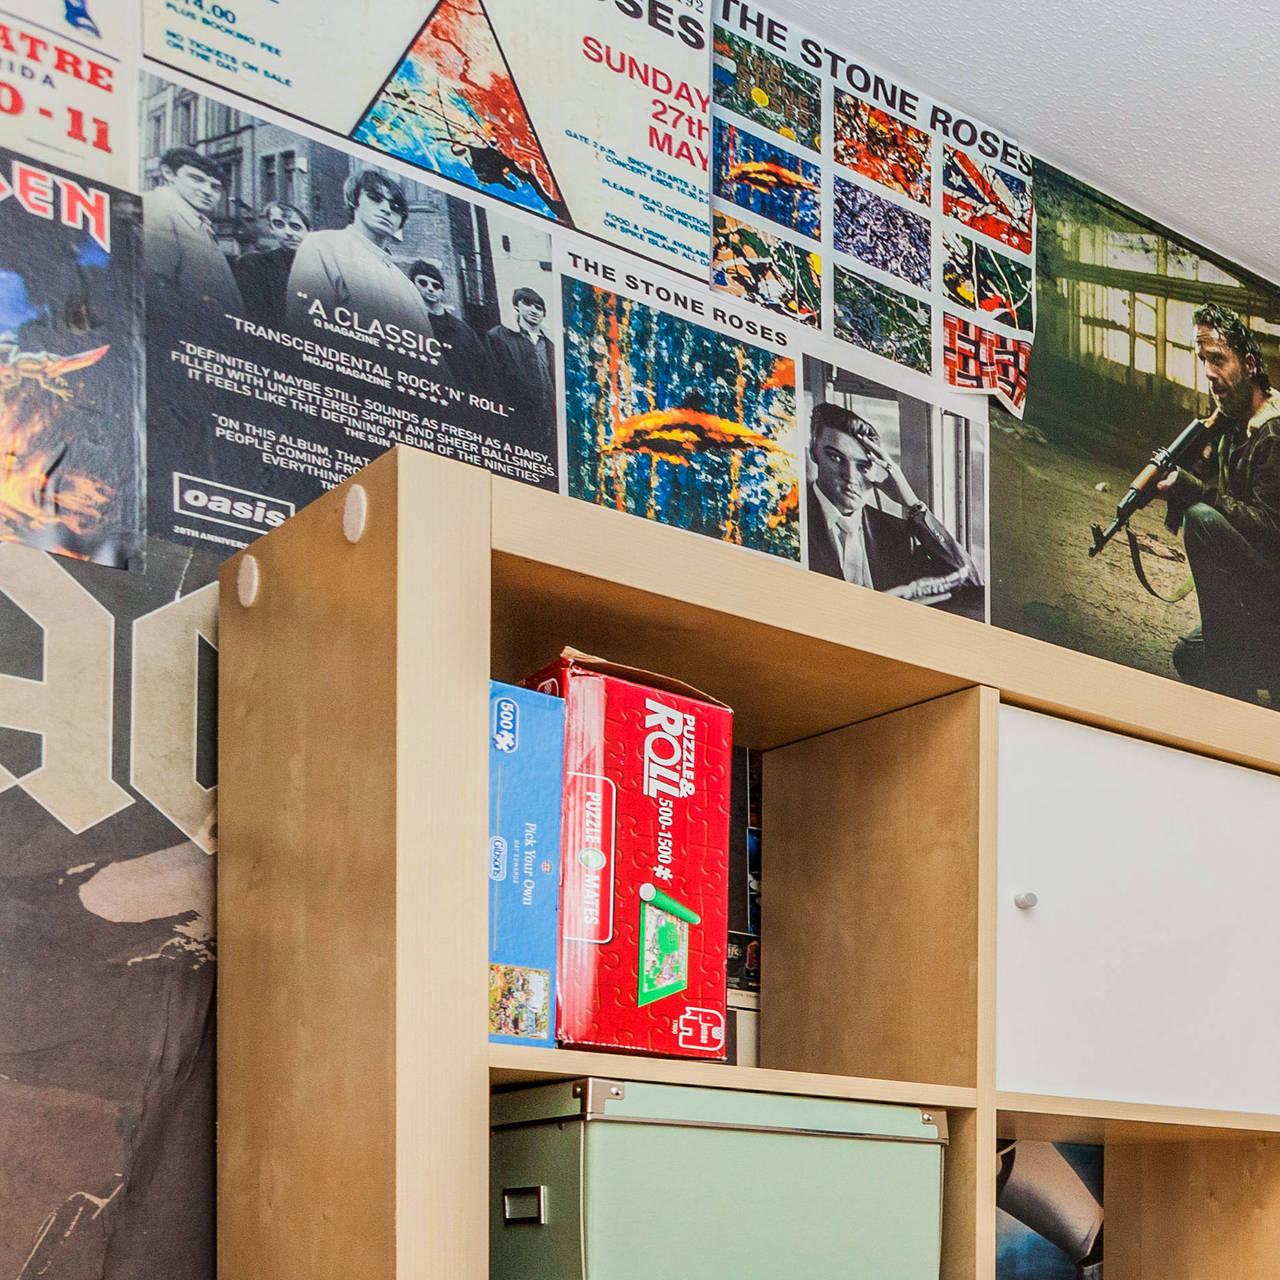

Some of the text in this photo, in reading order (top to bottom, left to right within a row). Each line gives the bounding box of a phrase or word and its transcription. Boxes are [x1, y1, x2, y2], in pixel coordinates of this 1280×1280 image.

[165, 2, 282, 57] PLUS BOOKING FEE
[0, 60, 56, 90] IDA
[165, 29, 293, 88] NO TICKETS ON SALE
[189, 48, 211, 63] THE
[215, 59, 239, 74] DAY
[582, 35, 711, 114] SUNDAY
[720, 0, 1033, 177] THE STONE ROSES
[651, 98, 710, 141] 27th
[564, 128, 690, 189] GATE SHOW STARTS
[605, 154, 674, 190] CONCERT ENDS
[648, 125, 710, 173] MAY
[0, 158, 111, 254] EN
[601, 177, 711, 229] PLEASE READ CONDITION
[643, 203, 711, 238] ON THE REVERS
[603, 219, 698, 263] ON SPIKE ISLAND ALL
[605, 211, 668, 243] FOOD DRINK
[567, 250, 788, 348] THE STONE ROSES
[313, 318, 381, 348] Q MAGAZINE
[302, 353, 392, 389] MOJO MAGAZINE
[397, 371, 442, 396] ROCK
[171, 350, 224, 375] FILLED
[226, 366, 264, 388] WITH
[267, 380, 358, 416] UNFETTERED
[361, 408, 404, 430] SPIRIT
[405, 424, 434, 443] AND
[436, 431, 478, 454] SHEER
[187, 368, 201, 381] IT
[205, 373, 251, 396] FEELS
[255, 388, 287, 407] LIKE
[290, 398, 318, 417] THE
[321, 409, 385, 437] DEFINING
[388, 431, 434, 452] ALBUM
[437, 443, 453, 456] OF
[456, 448, 482, 466] THE
[274, 370, 321, 394] MAYBE
[324, 385, 362, 407] STILL
[364, 399, 419, 424] SOUNDS
[421, 416, 439, 430] AS
[441, 422, 482, 443] FRESH
[484, 433, 501, 449] AS
[503, 441, 513, 452] A
[215, 426, 332, 469] PEOPLE COMING
[243, 422, 276, 441] THIS
[335, 449, 371, 467] THAT
[344, 427, 391, 448] THE SUN
[262, 452, 349, 484] EVERYTHING
[173, 524, 199, 538] 20TH
[183, 489, 287, 528] oasis
[499, 701, 515, 730] 500
[643, 697, 684, 798] ROLL
[682, 712, 696, 780] PUZZLE
[657, 796, 674, 865] 500-1500
[521, 821, 538, 906] Pick Your Own
[583, 791, 601, 926] PUZZLE MATES
